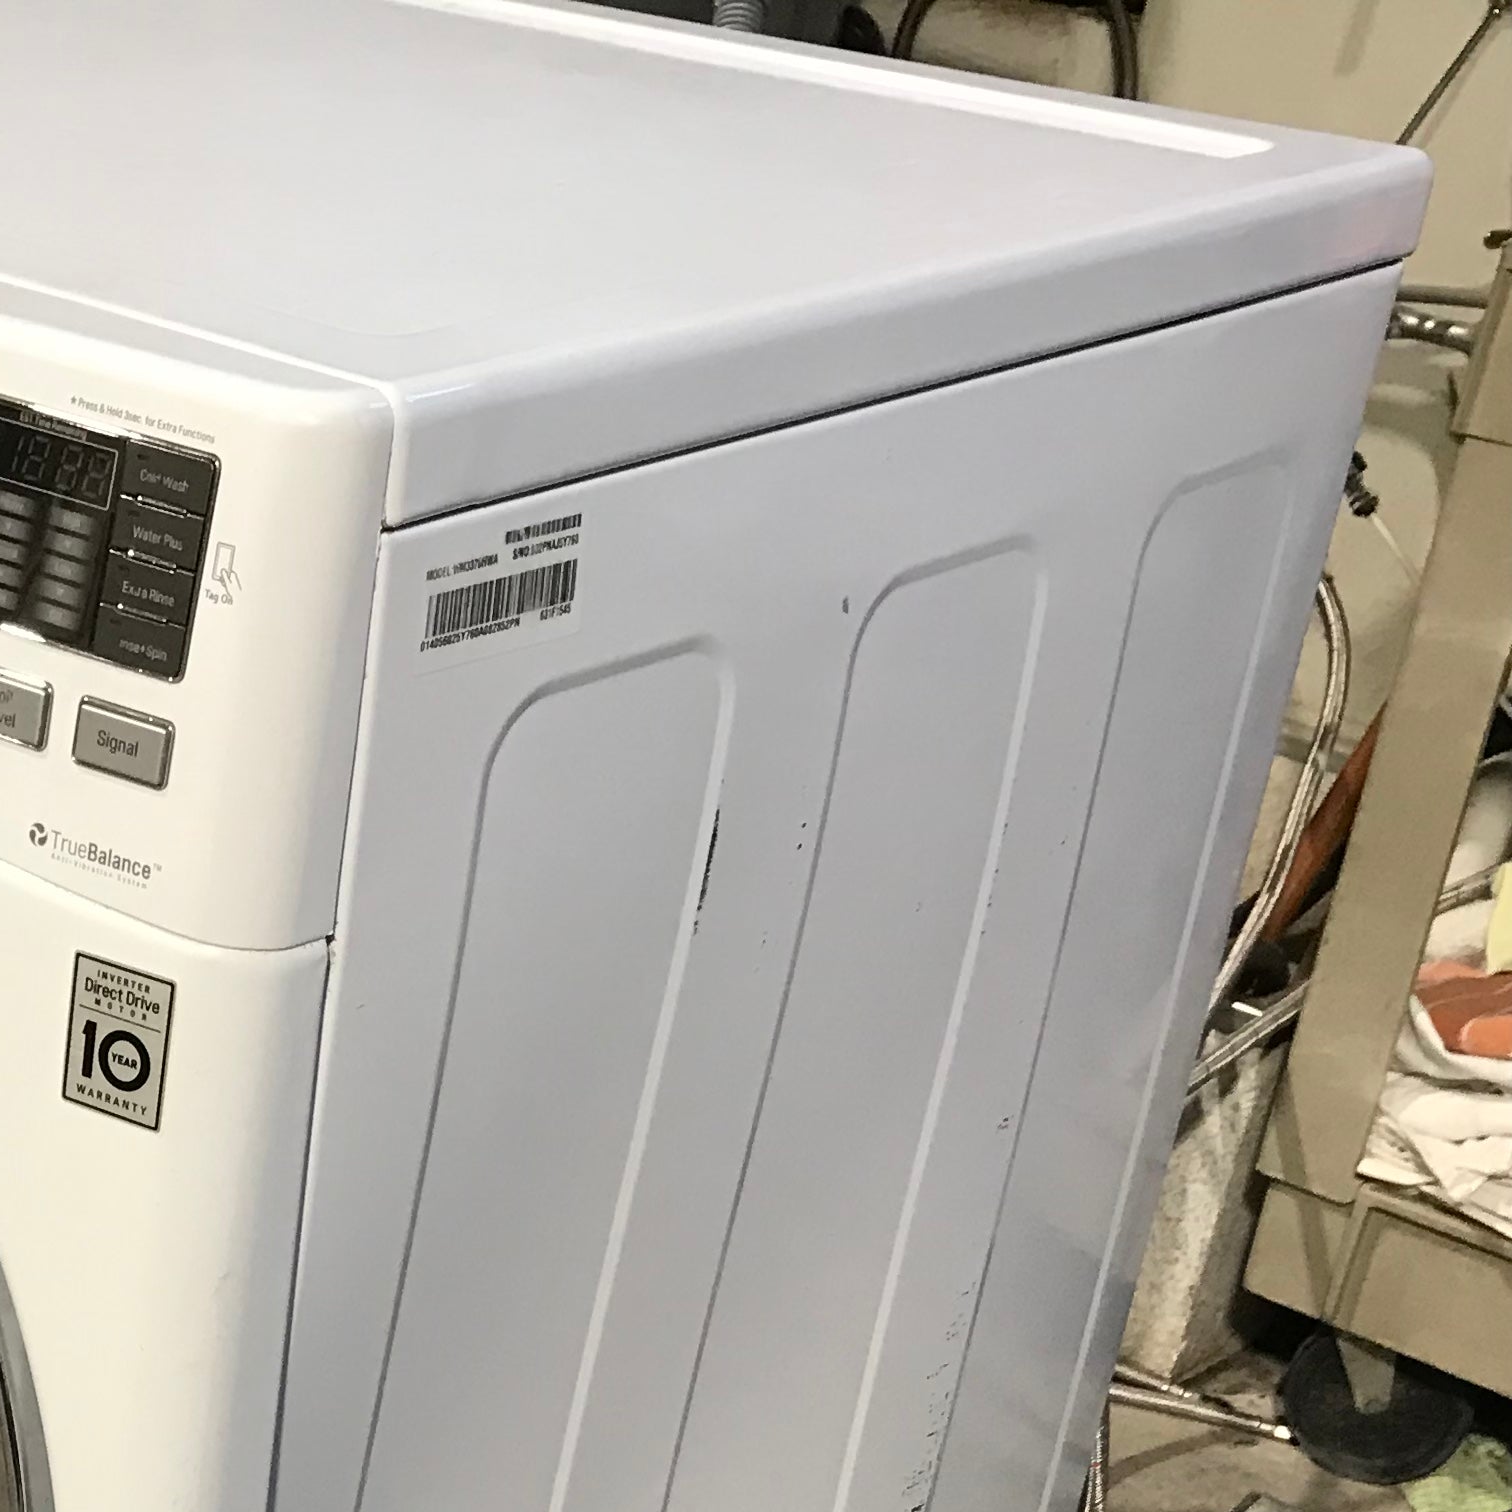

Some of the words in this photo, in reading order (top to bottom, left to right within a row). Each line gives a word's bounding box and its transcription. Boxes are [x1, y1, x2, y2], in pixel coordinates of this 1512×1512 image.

[77, 397, 98, 413] Press
[106, 405, 124, 419] Hold
[157, 419, 177, 434] Extra
[178, 424, 216, 445] Functions
[133, 524, 162, 544] Water
[205, 588, 219, 605] Tag
[96, 729, 139, 758] Signal
[84, 976, 123, 1003] Direct
[125, 990, 160, 1014] Drive
[96, 969, 151, 994] INVERTER
[94, 997, 147, 1021] MOTOR
[81, 1018, 151, 1093] 10
[110, 1051, 139, 1071] YEAR
[76, 1082, 148, 1117] WARRANTY
